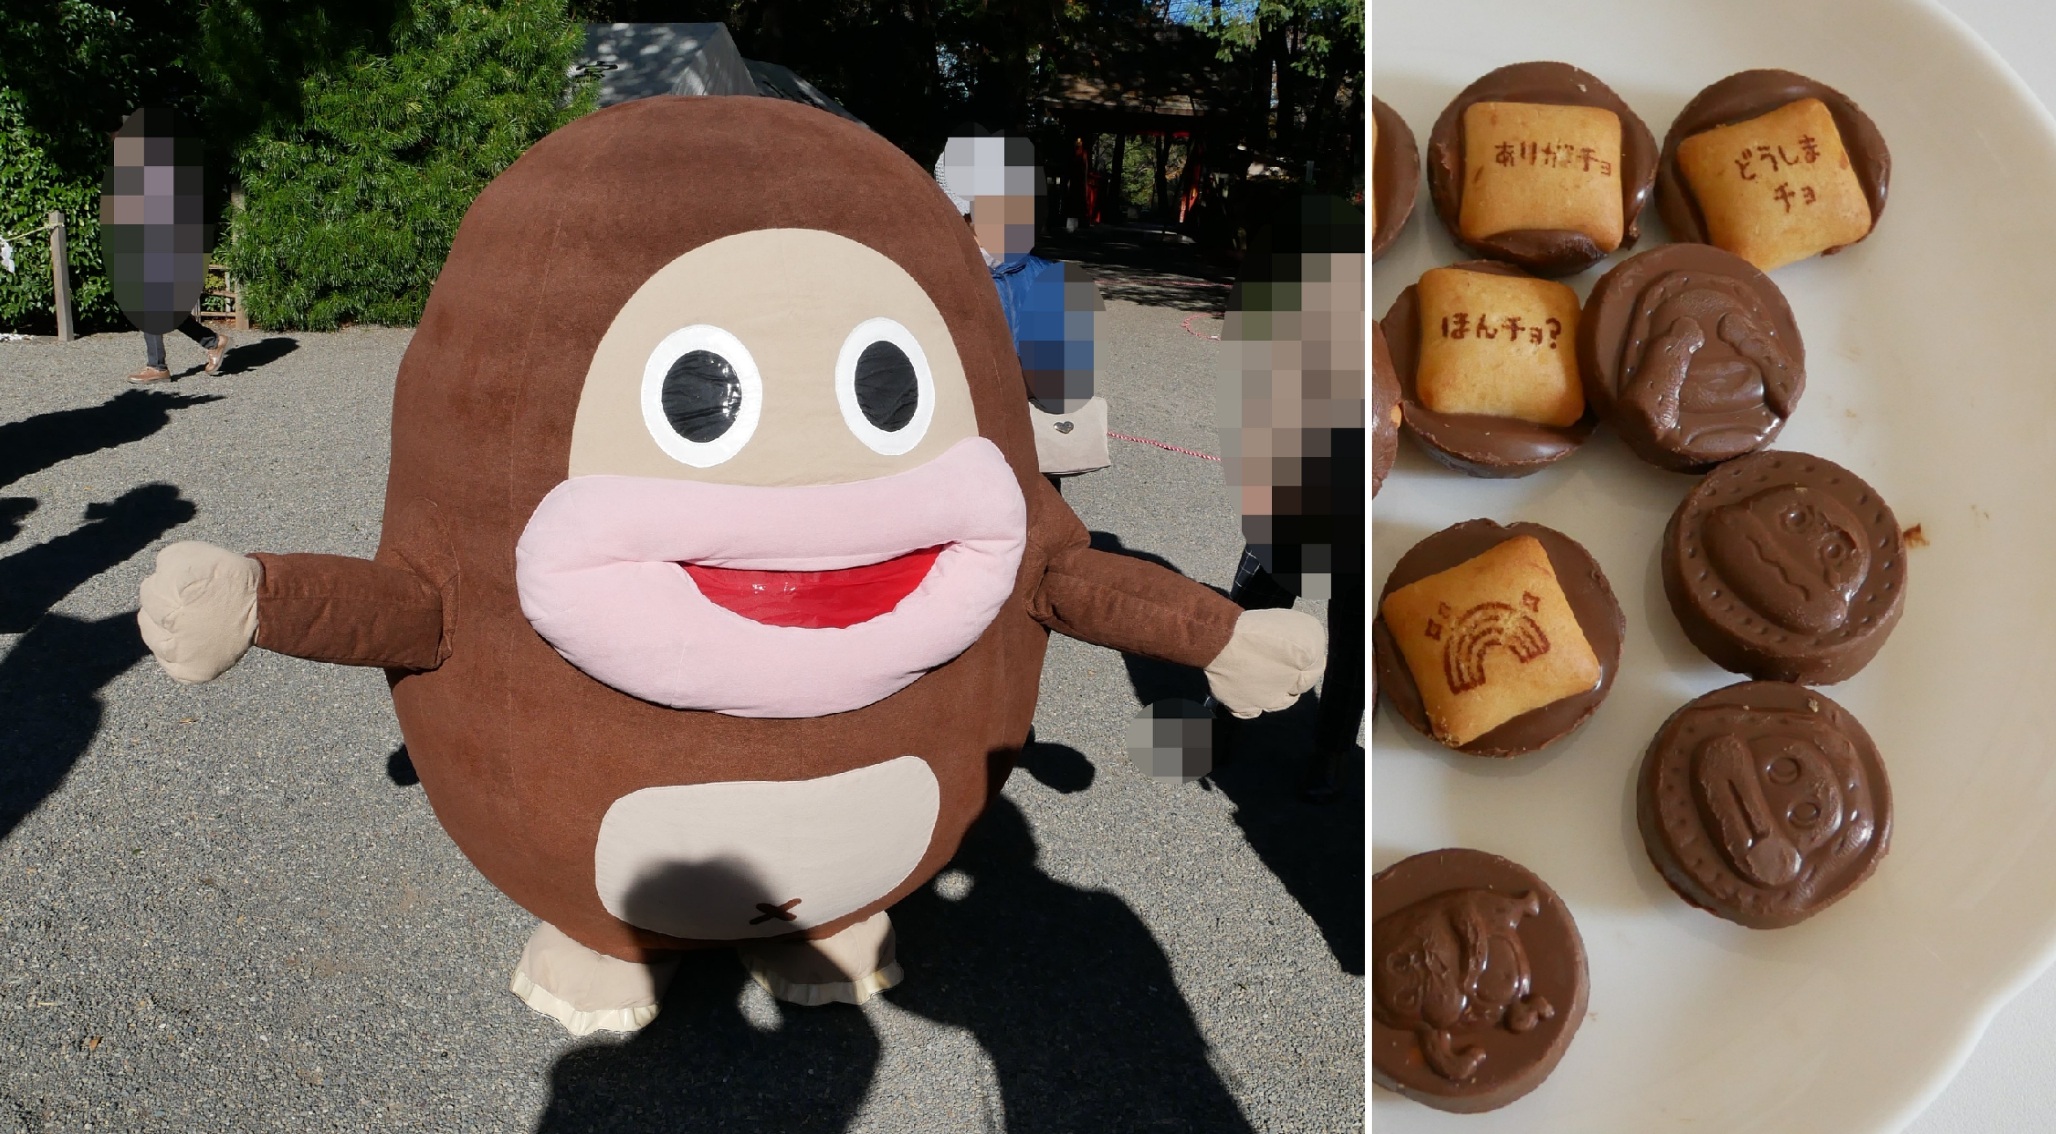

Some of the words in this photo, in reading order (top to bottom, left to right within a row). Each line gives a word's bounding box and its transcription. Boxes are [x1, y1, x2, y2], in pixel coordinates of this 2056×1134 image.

[1734, 134, 1821, 180] どうしま
[1773, 182, 1817, 214] チョ
[1441, 312, 1562, 350] ほんチョ?
